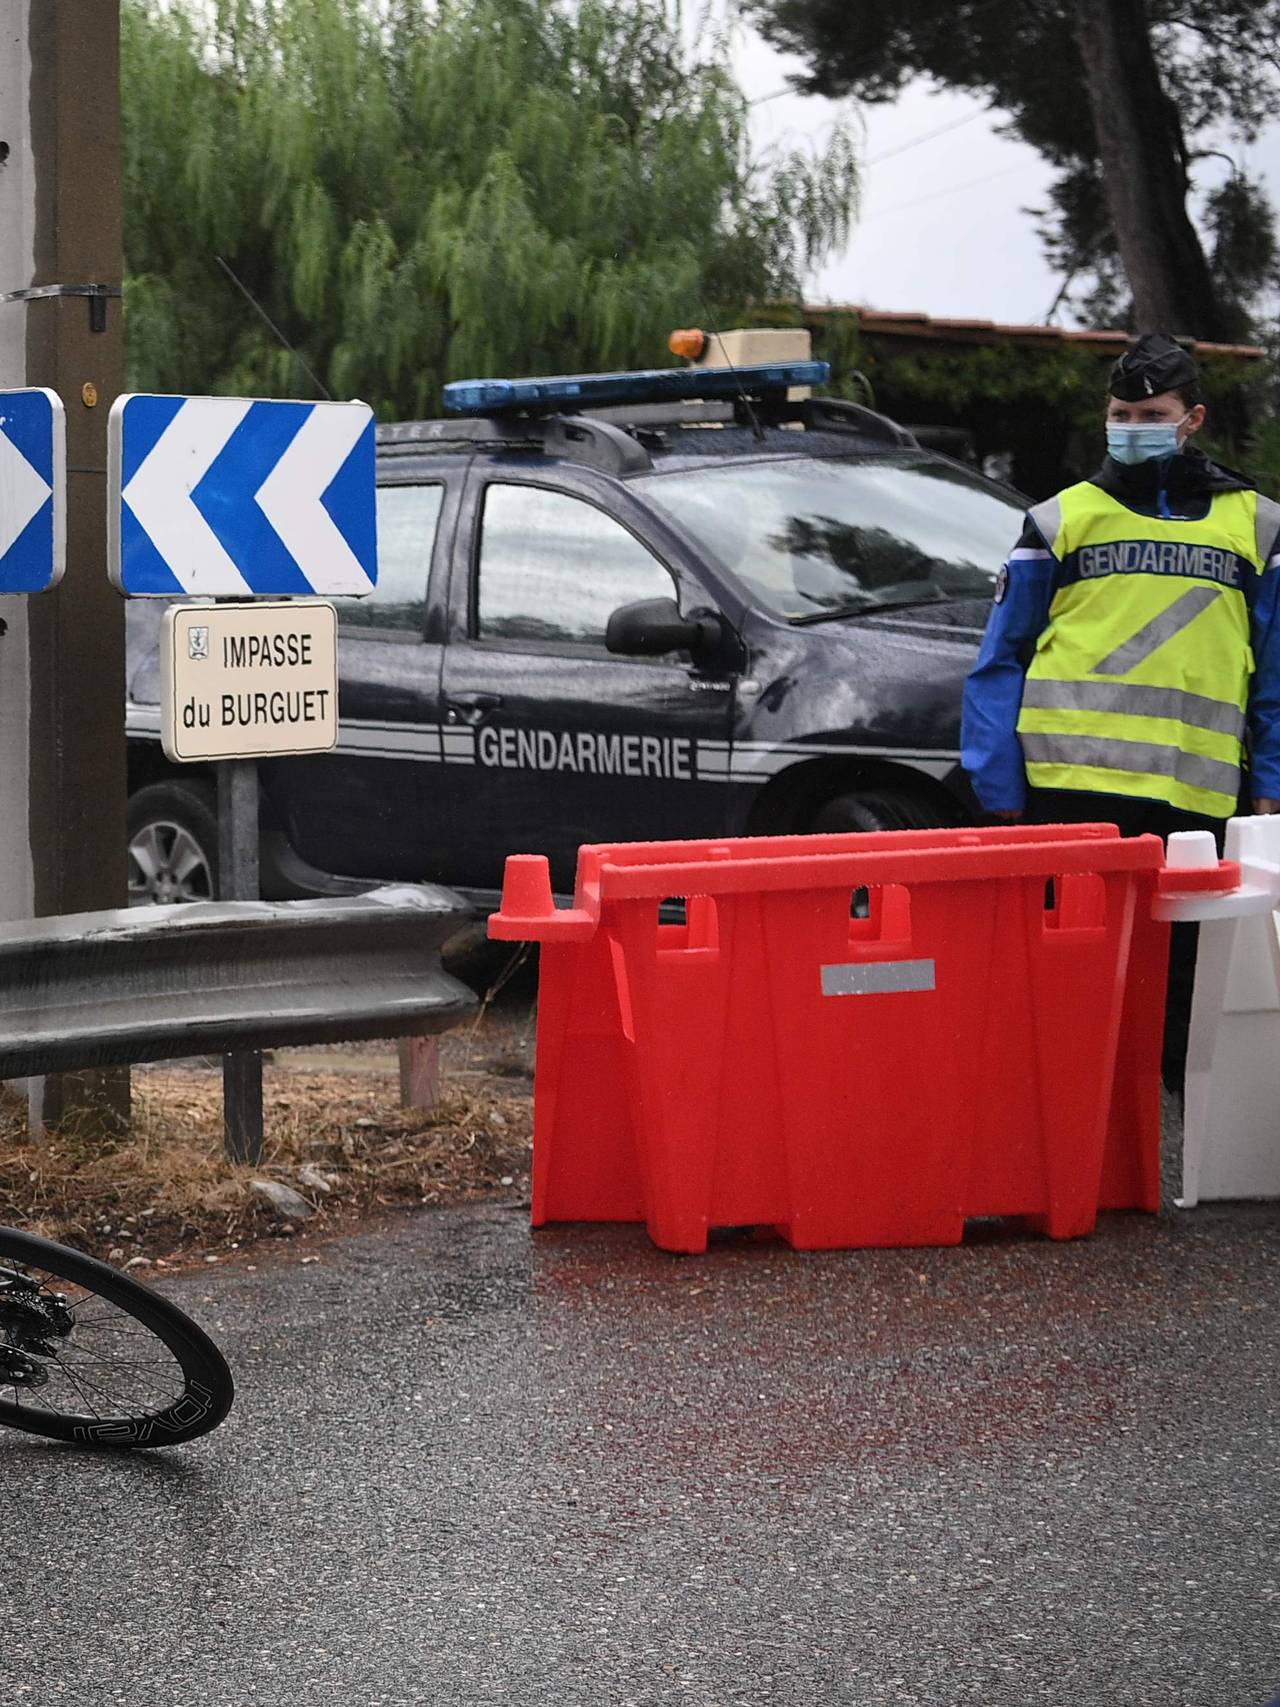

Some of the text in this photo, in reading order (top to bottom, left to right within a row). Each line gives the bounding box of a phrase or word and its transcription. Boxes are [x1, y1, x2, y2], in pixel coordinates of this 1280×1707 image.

[1079, 541, 1239, 586] GENDARMERIE
[223, 634, 313, 668] IMPASSE
[183, 690, 329, 728] du BURGUET
[479, 726, 691, 780] GENDARMERIE
